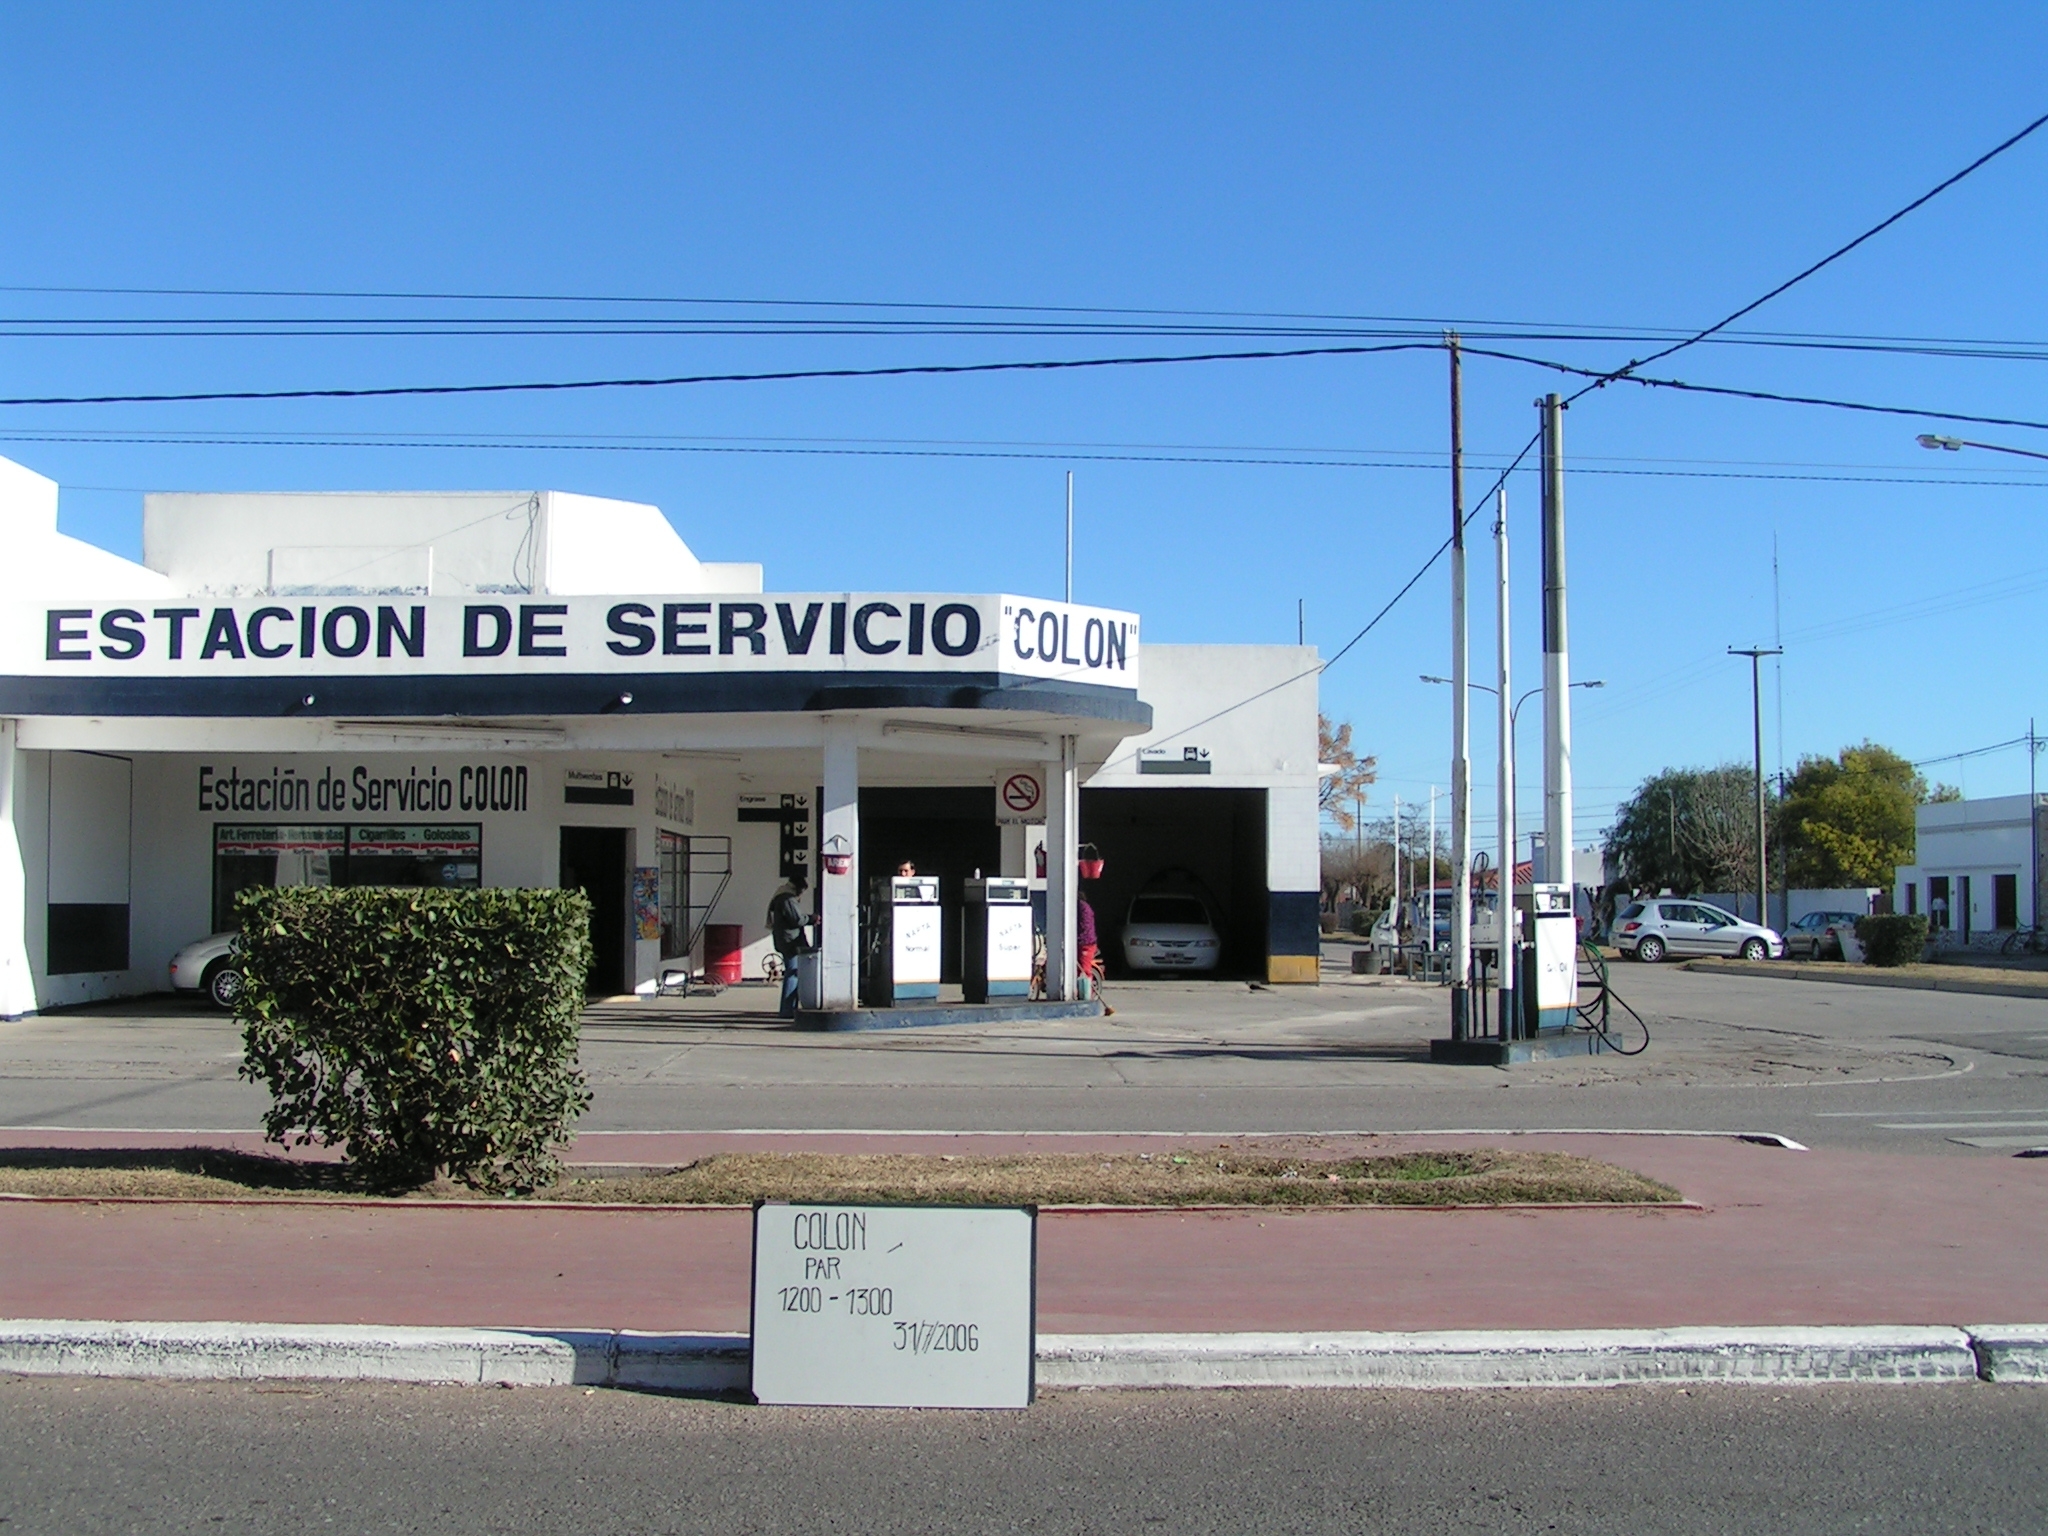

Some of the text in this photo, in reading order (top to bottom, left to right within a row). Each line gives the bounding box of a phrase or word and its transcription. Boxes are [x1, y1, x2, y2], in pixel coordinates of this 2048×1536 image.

[45, 605, 426, 661] ESTACION
[462, 604, 568, 658] DE
[605, 601, 981, 657] SERVICIO
[316, 765, 346, 812] de
[351, 765, 453, 812] Servicio
[459, 765, 528, 812] COLON
[358, 828, 471, 842] Cigarrillos Golosinas
[794, 1212, 866, 1250] COLON
[805, 1257, 841, 1280] PAR
[778, 1286, 822, 1313] 1200
[845, 1287, 893, 1316] 1300
